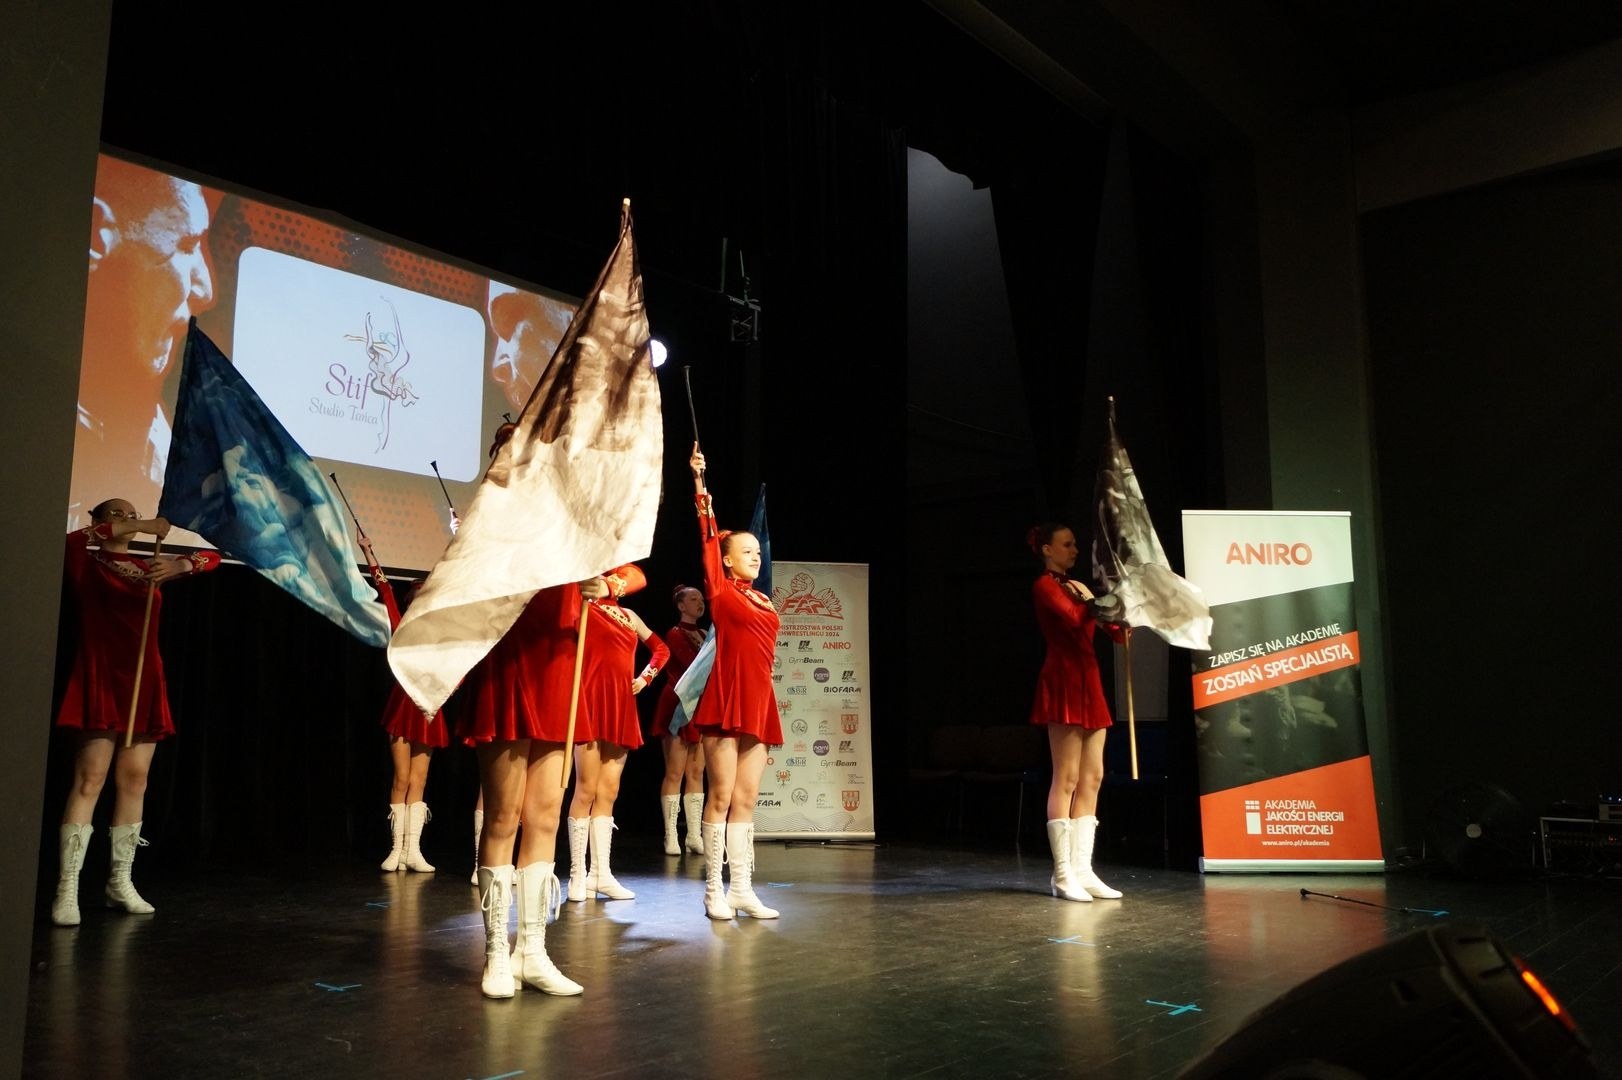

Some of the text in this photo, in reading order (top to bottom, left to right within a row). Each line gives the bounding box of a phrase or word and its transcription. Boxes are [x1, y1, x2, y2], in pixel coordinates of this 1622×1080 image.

[309, 397, 345, 418] Studio
[1226, 542, 1313, 566] ANIRO
[822, 641, 852, 650] ANIRO
[1208, 623, 1343, 668] ZAPISZ SIĘ NA AKADEMIĘ
[788, 656, 825, 665] GymBeam
[1203, 643, 1354, 695] ZOSTAŃ SPECJALISTĄ
[823, 686, 861, 694] BIOFARM
[820, 760, 857, 768] GymBeam
[1264, 800, 1317, 810] AKADEMIA
[1265, 810, 1344, 822] JAKOŚCI ENERGII
[1266, 824, 1334, 835] ELEKTRYCZNEJ
[1262, 839, 1330, 847] www.aniro.pl/akademia
